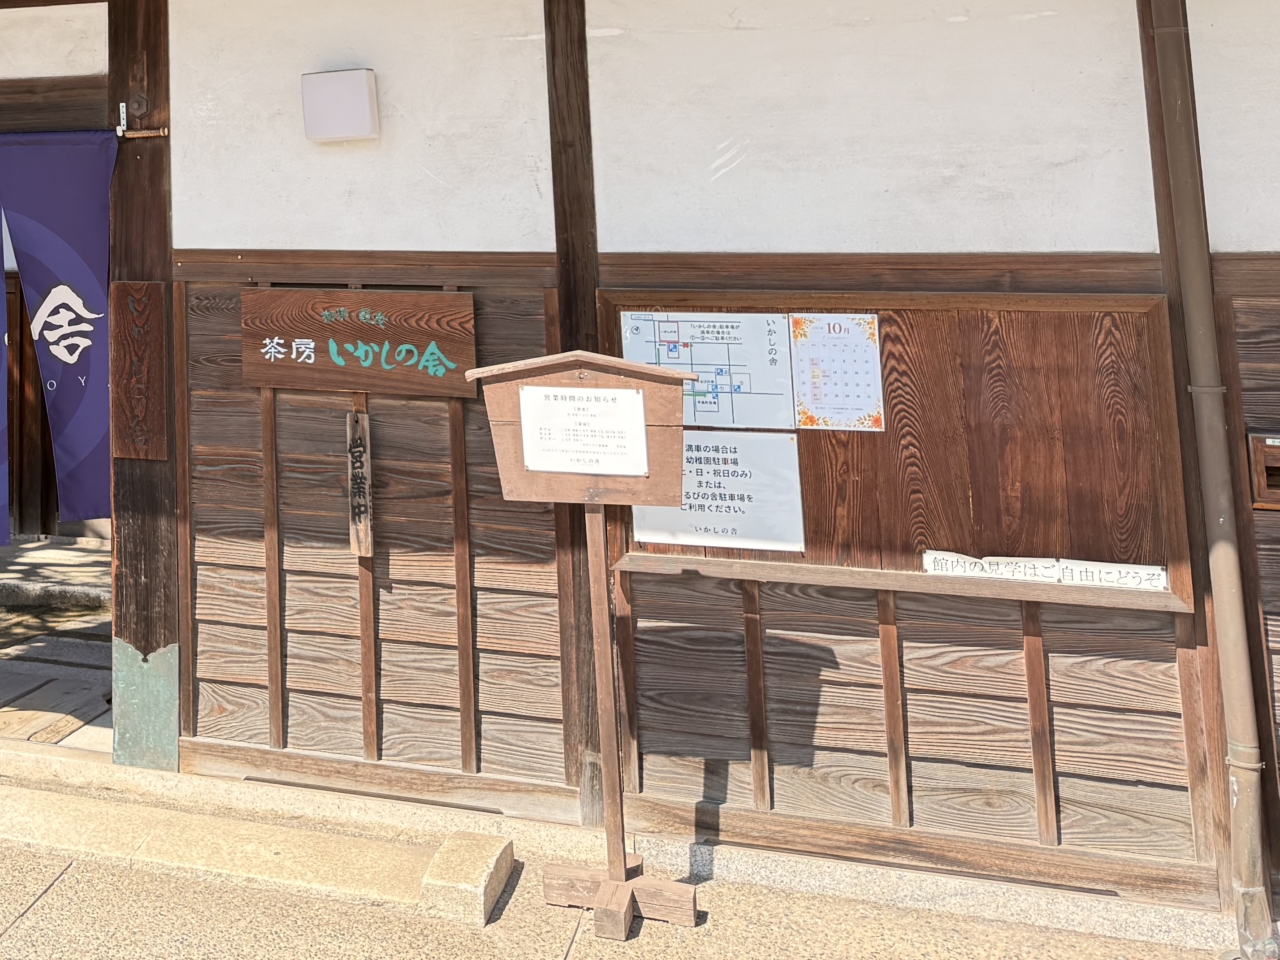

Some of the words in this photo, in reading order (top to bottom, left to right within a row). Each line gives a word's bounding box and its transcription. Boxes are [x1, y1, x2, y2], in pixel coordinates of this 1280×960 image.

[766, 319, 779, 367] いかしの舎
[260, 336, 316, 364] 茶房
[328, 337, 458, 378] いかしの舎
[685, 444, 738, 454] 満車の場合は
[685, 456, 739, 466] 幼稚園駐車場
[682, 468, 752, 479] ・日・祝日のみ）
[348, 437, 367, 524] 営業中
[696, 480, 726, 489] または、
[684, 491, 754, 503] るびの舎駐車場を
[681, 503, 746, 515] ご利用ください。
[694, 526, 738, 536] いかしの舎
[932, 556, 1163, 589] 館内の見学はご自由にどうぞ
